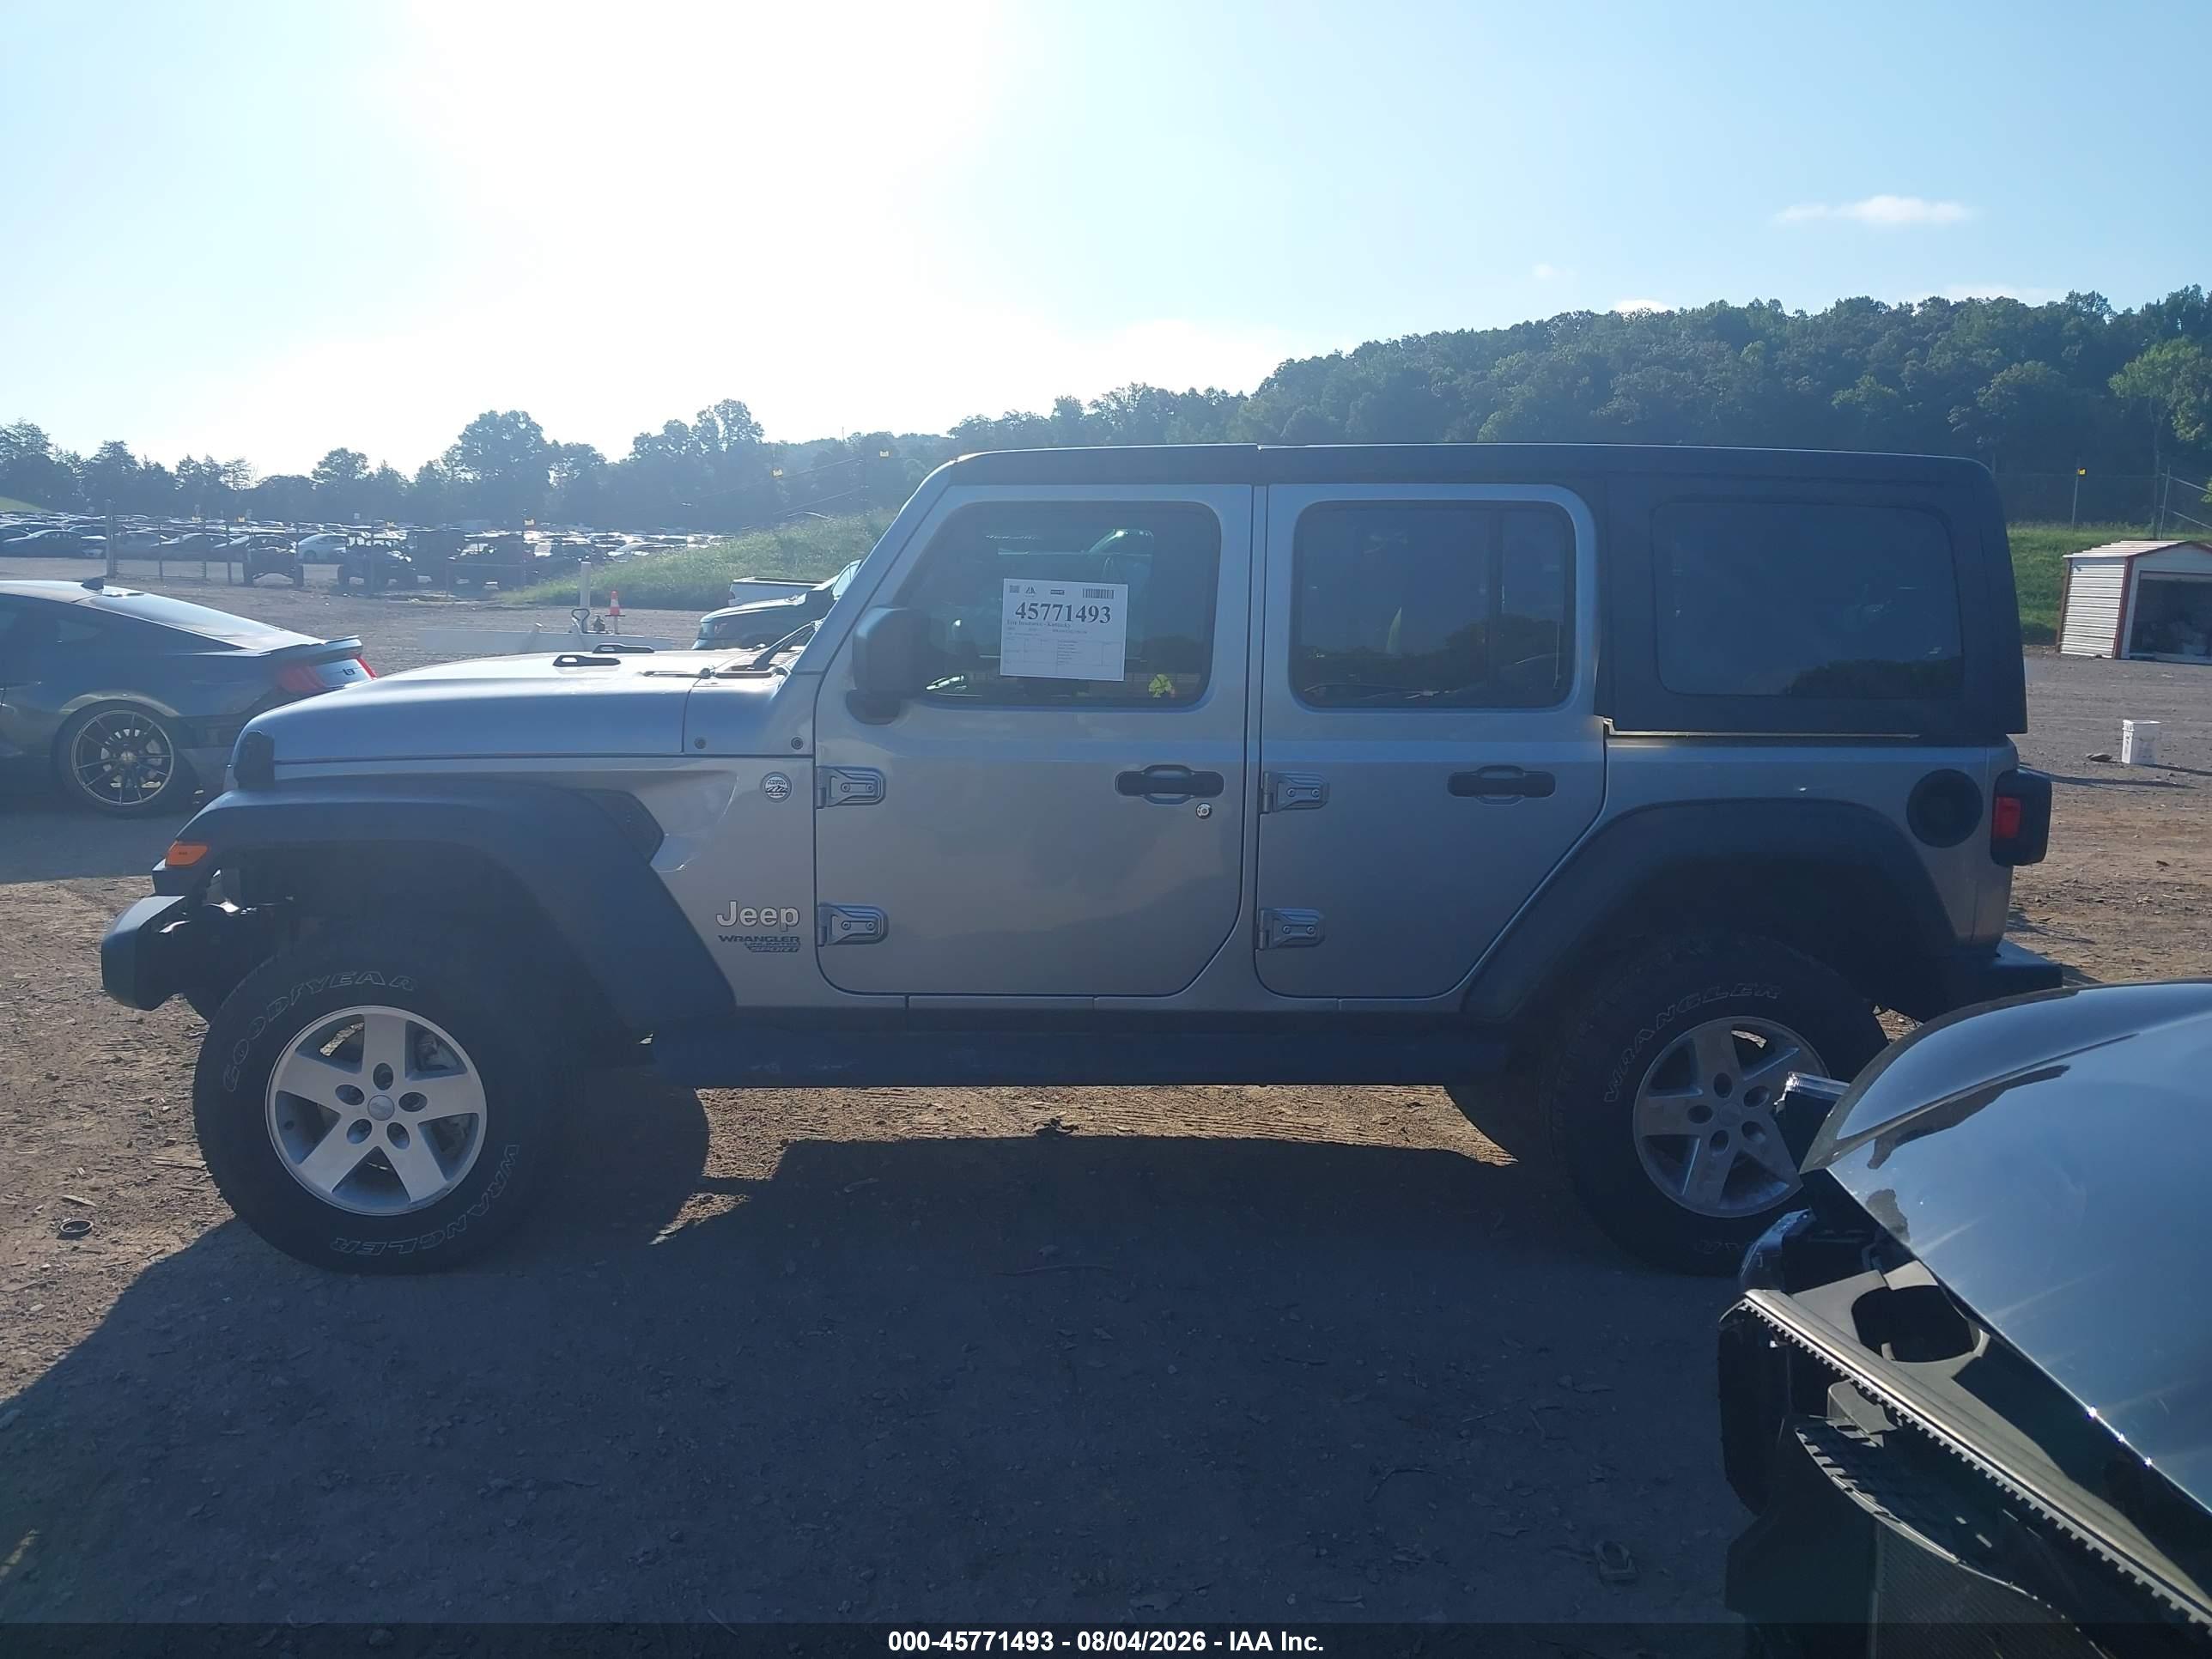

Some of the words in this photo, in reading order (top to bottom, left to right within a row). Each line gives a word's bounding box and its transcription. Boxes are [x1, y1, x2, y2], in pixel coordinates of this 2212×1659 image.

[1015, 601, 1111, 624] 45771493
[716, 899, 800, 932] Jeep
[1604, 982, 1782, 1103] WRANGLER
[330, 1144, 520, 1256] WRANGLER
